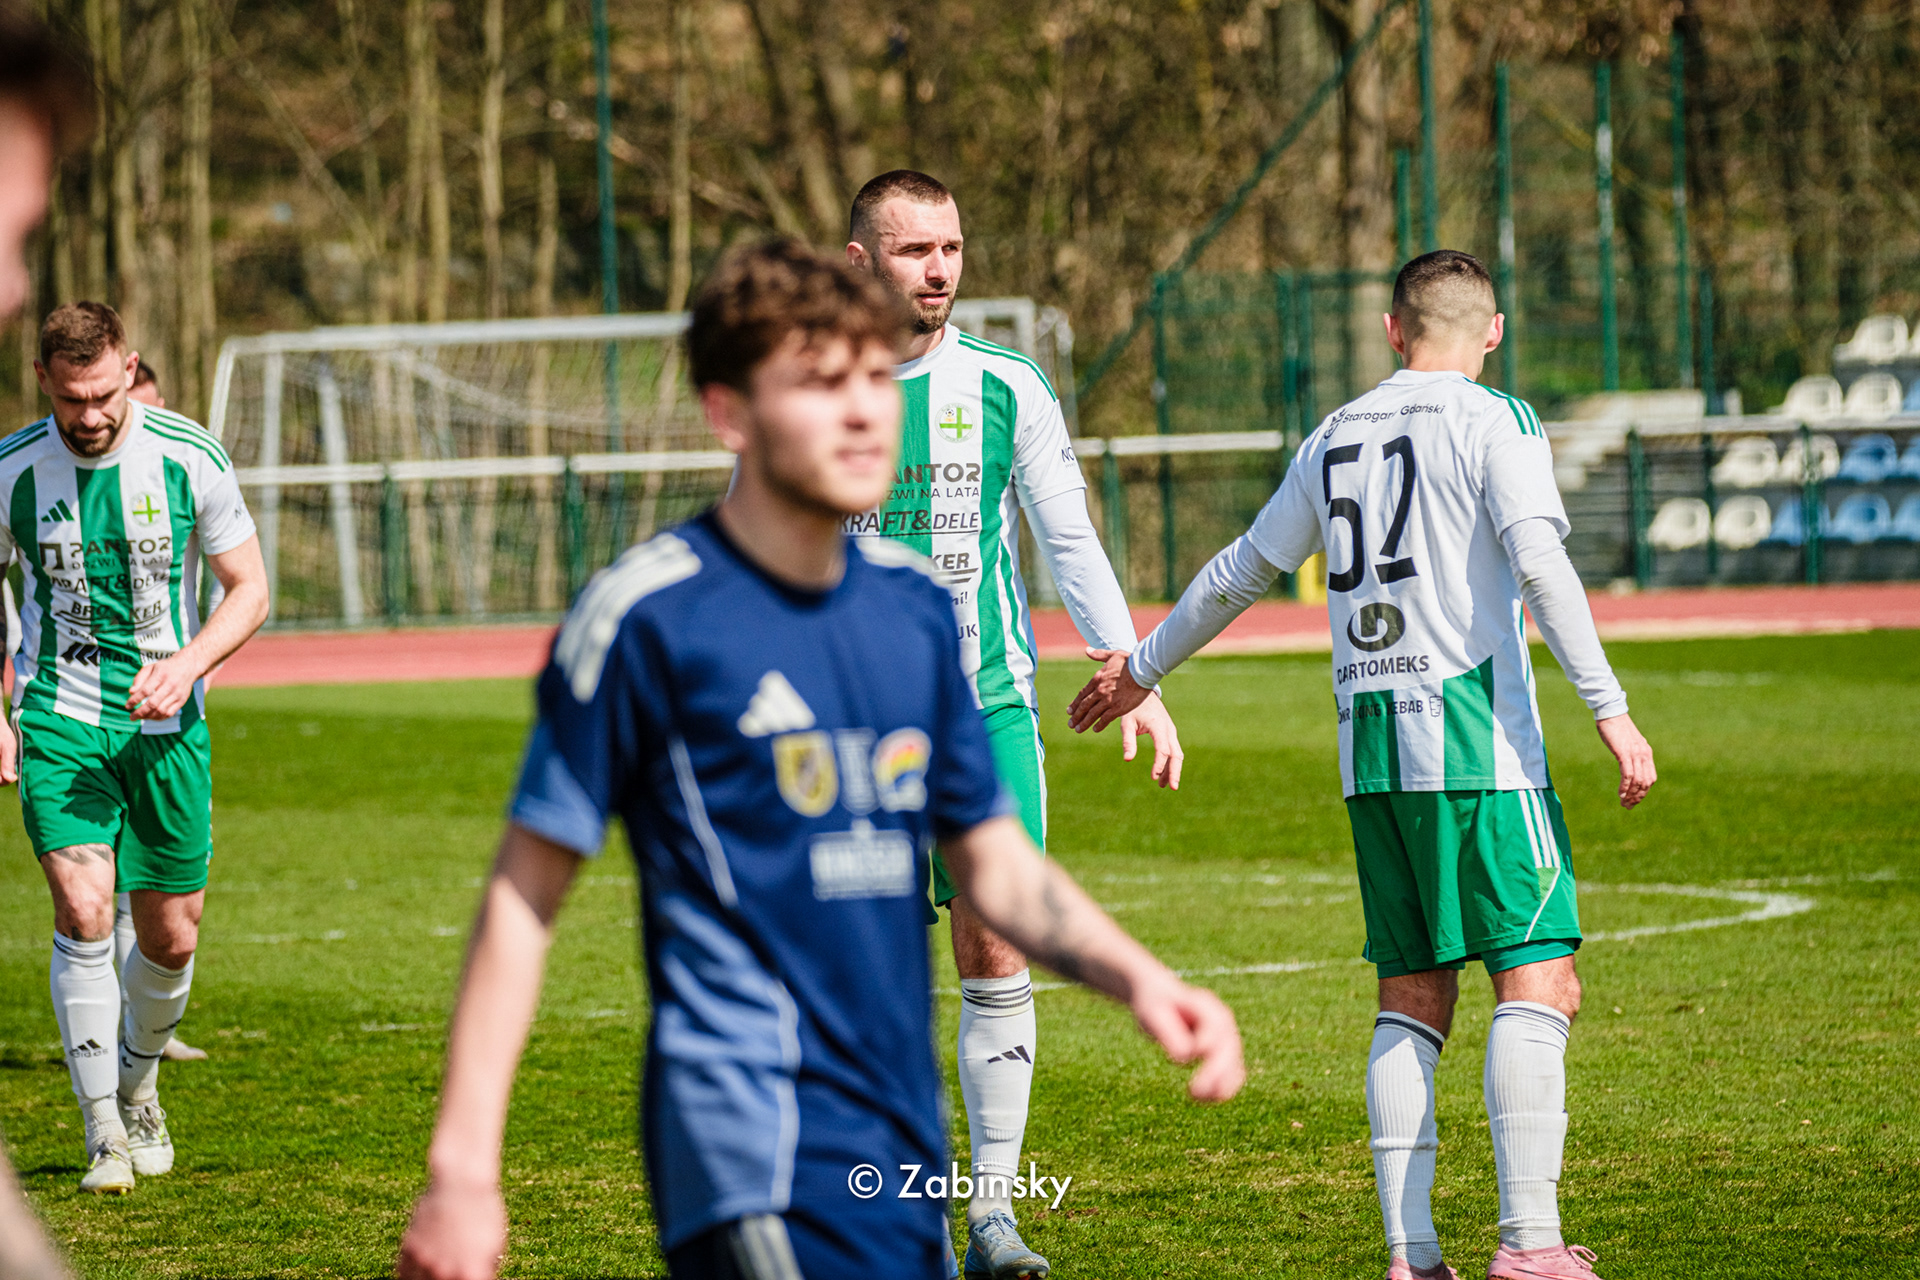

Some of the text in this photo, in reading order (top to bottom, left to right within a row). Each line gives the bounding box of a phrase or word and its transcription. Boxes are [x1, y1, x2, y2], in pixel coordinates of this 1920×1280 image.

[1400, 403, 1446, 416] Gdański
[888, 462, 981, 485] ANTOR
[885, 486, 980, 500] ZWI NA LATA
[1322, 434, 1420, 593] 52
[1337, 655, 1430, 685] DARTOMEKS
[1354, 703, 1381, 719] KING
[1387, 700, 1424, 716] KEBAB
